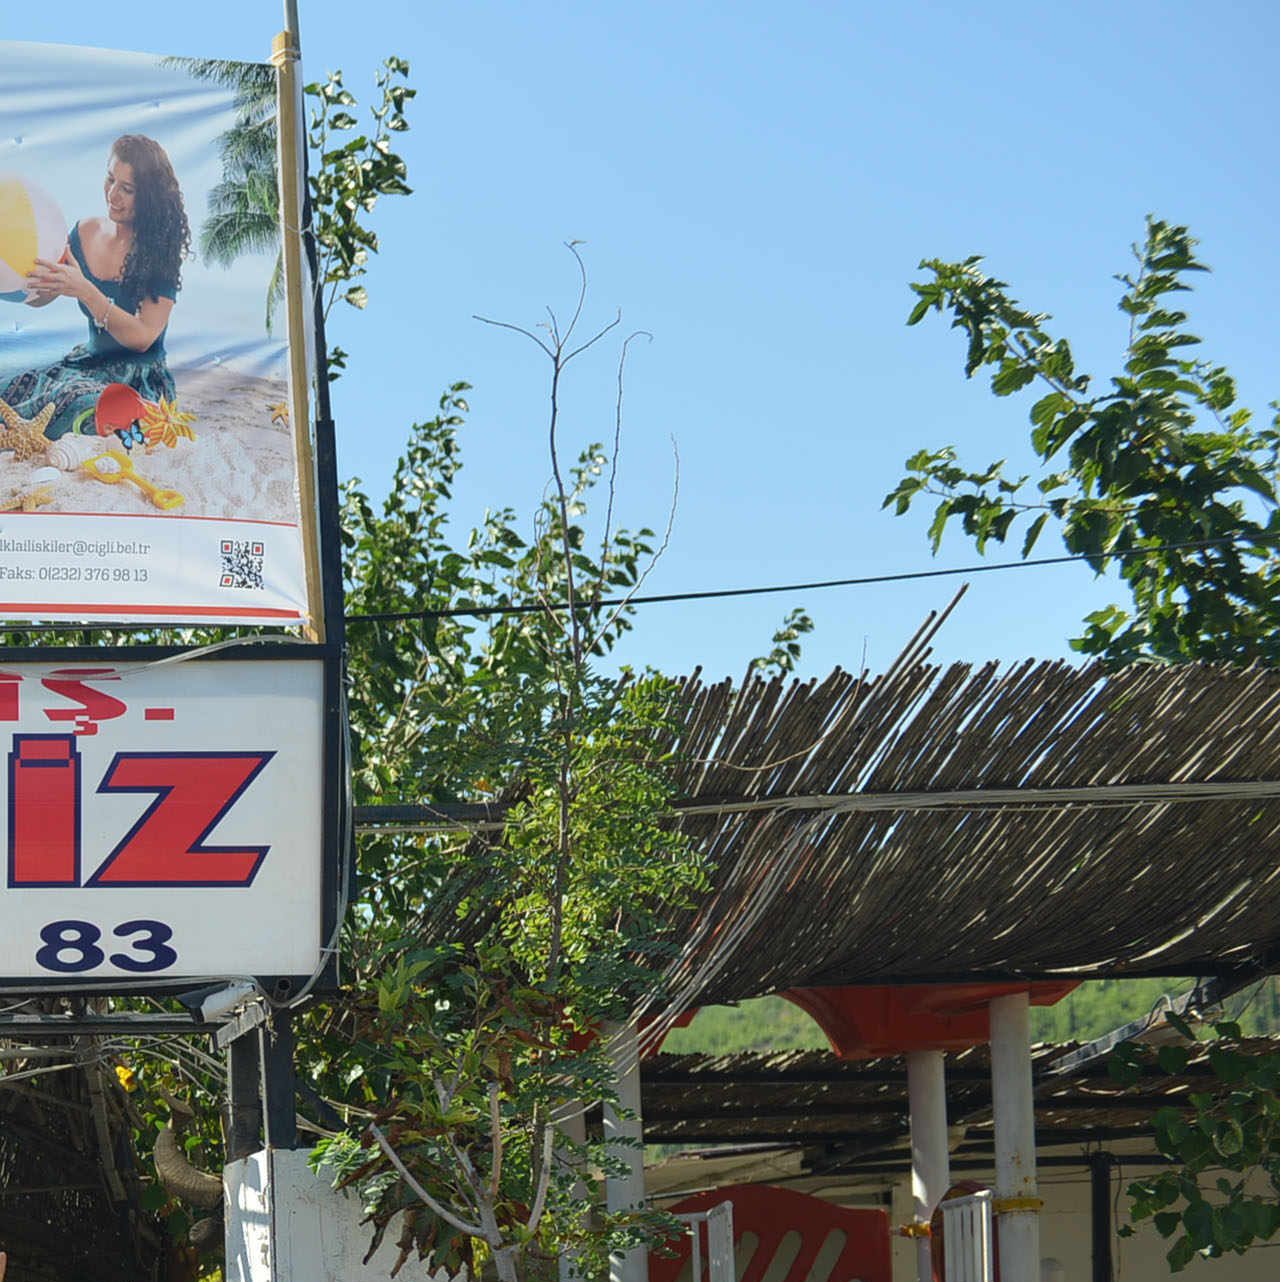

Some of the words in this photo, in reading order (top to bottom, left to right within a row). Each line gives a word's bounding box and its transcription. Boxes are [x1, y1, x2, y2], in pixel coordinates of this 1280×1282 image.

[0, 567, 36, 580] Faks:
[38, 567, 82, 582] 0(232)
[84, 568, 110, 581] 376
[112, 568, 131, 582] 98
[134, 568, 149, 582] 13
[36, 919, 179, 974] 83
